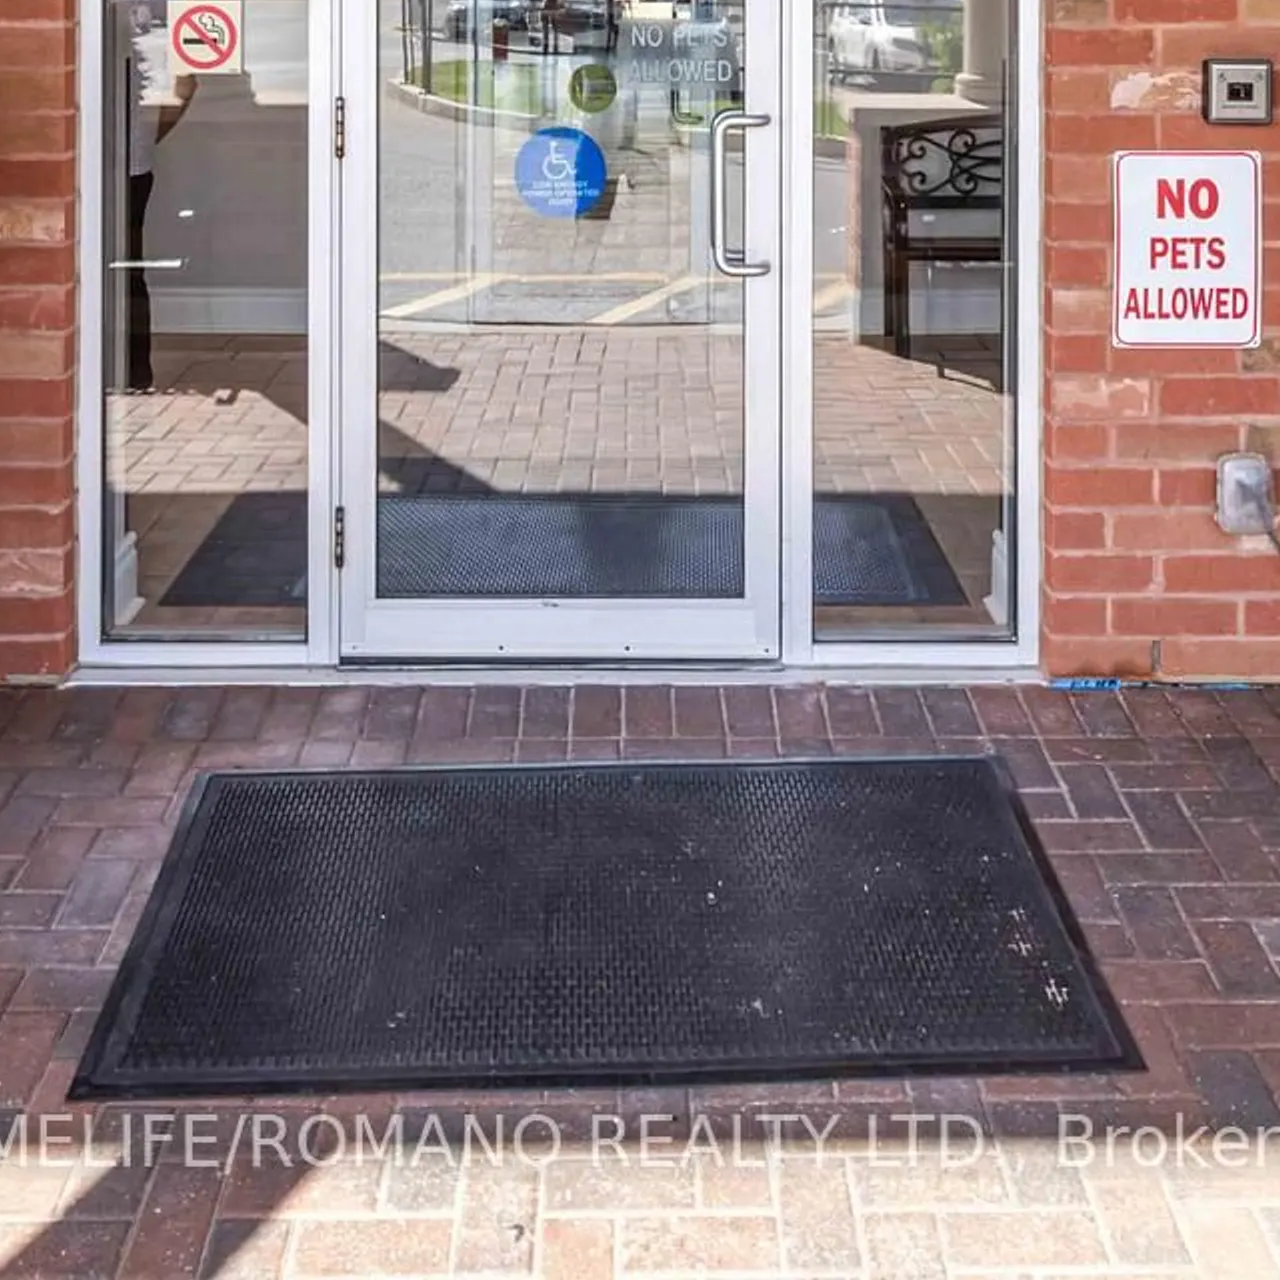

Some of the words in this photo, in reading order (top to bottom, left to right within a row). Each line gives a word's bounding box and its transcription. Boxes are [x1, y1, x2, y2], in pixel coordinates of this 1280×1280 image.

[631, 26, 663, 48] NO
[629, 59, 733, 83] ALLOWED
[1156, 178, 1220, 220] NO
[1150, 237, 1226, 270] PETS
[1123, 287, 1249, 320] ALLOWED
